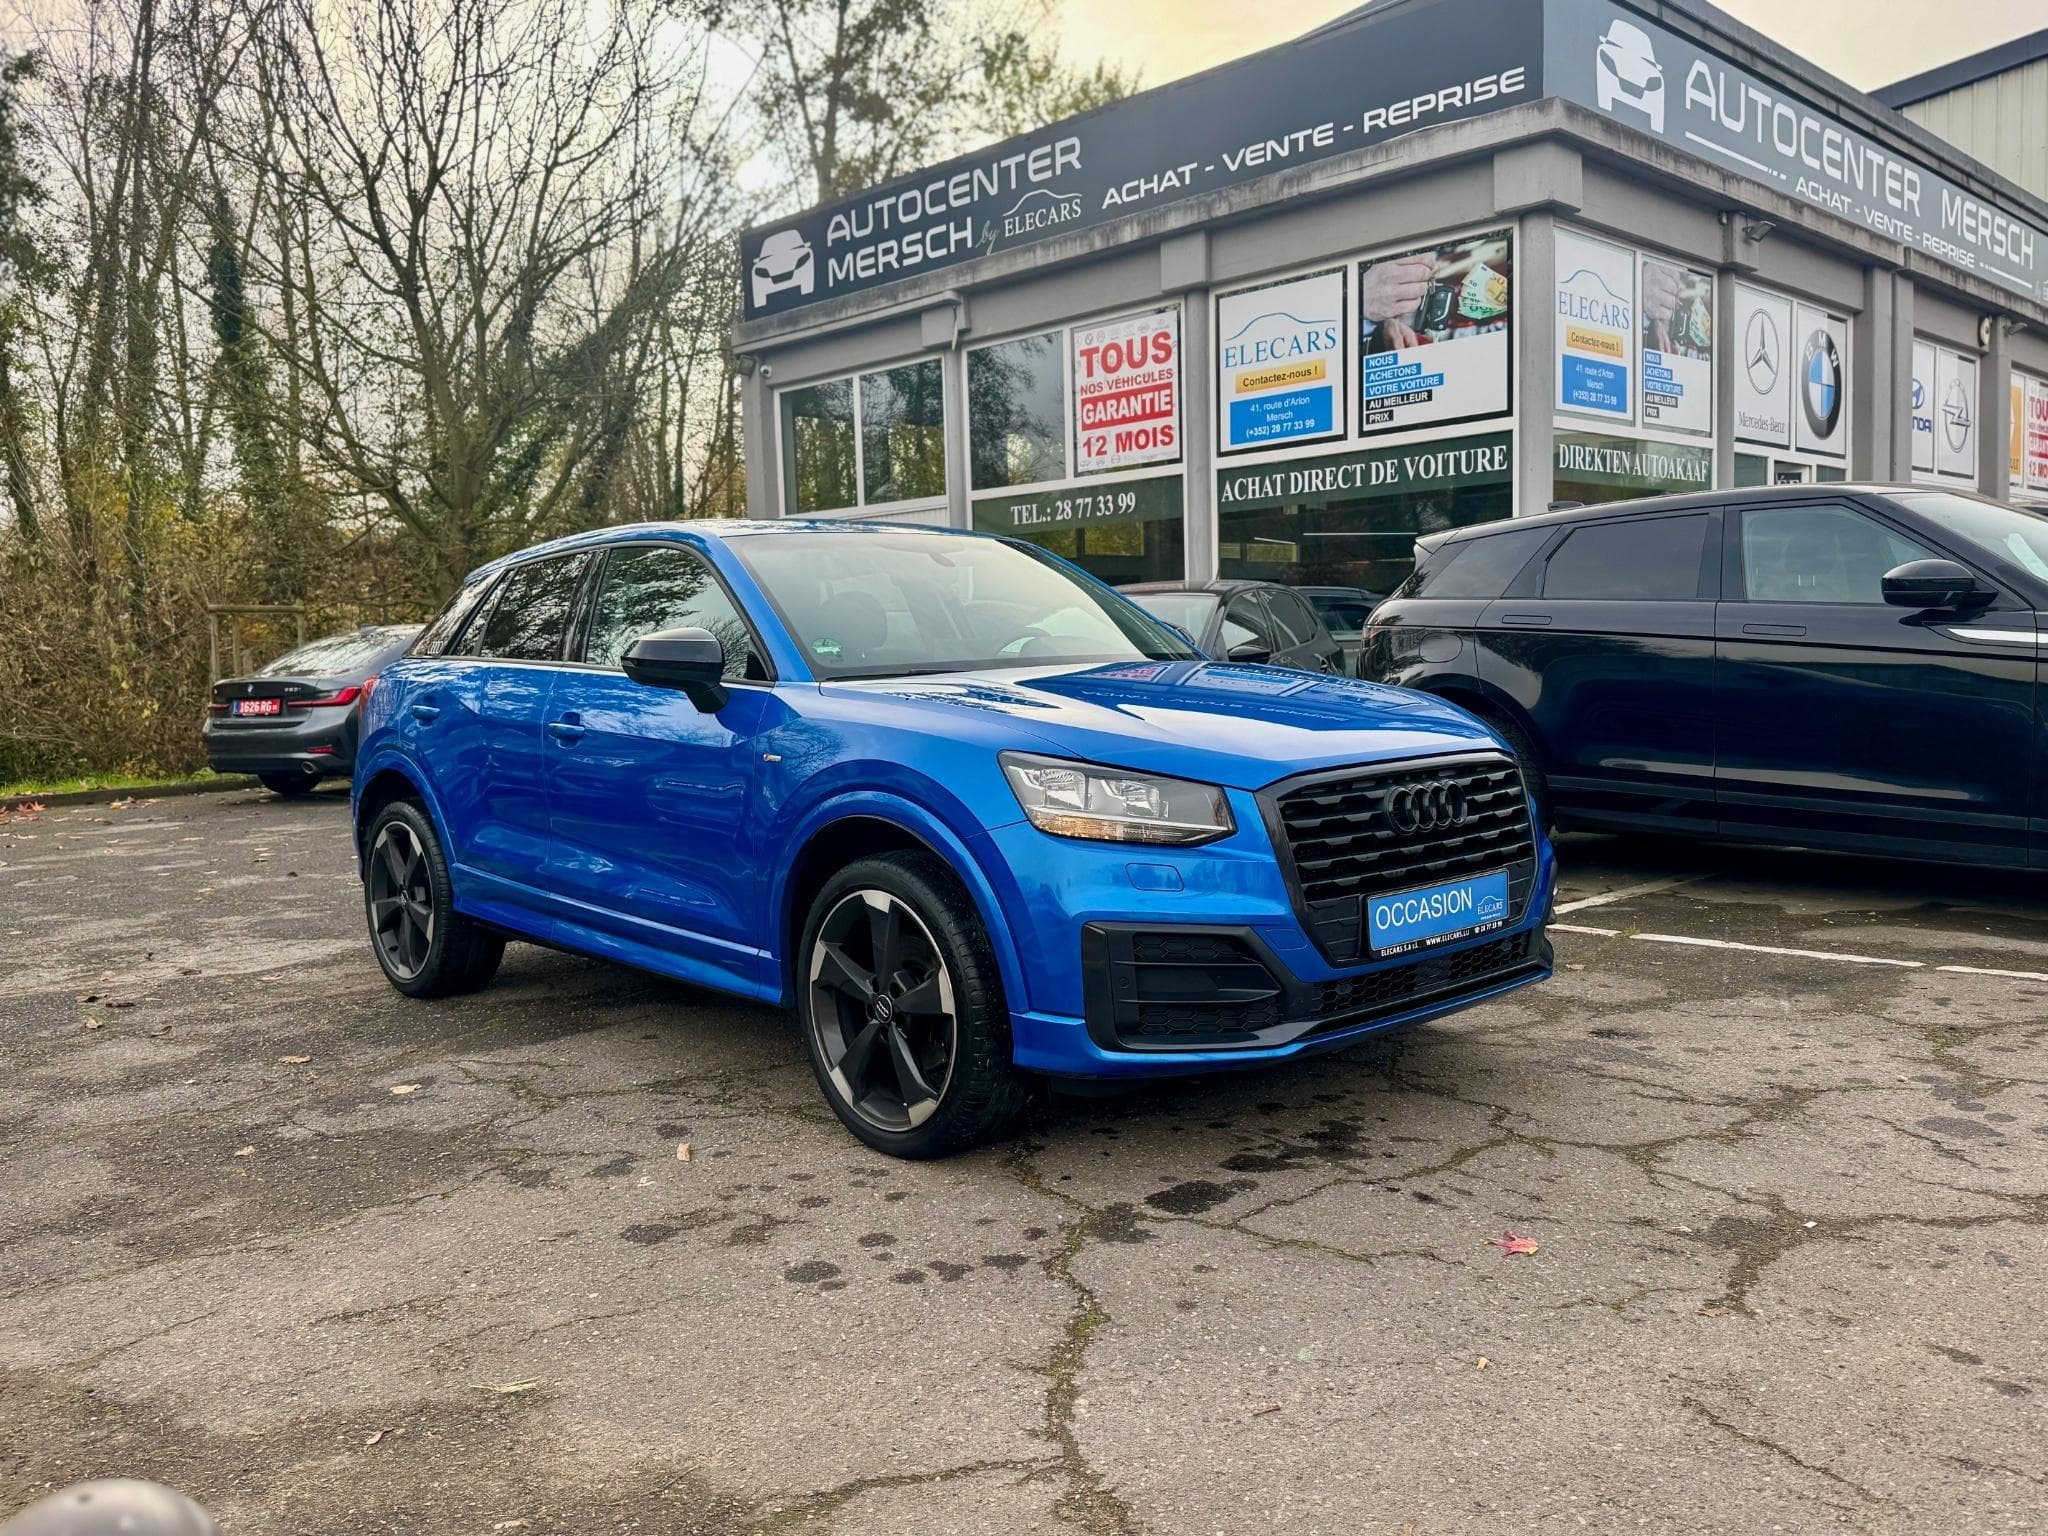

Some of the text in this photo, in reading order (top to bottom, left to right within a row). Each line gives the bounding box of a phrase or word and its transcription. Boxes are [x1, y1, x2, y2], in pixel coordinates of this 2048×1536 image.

[1101, 162, 1198, 210] ACHAT
[1222, 123, 1334, 172] VENTE
[1363, 66, 1526, 134] REPRISE
[1686, 60, 2034, 269] AUTOCENTER MERSCH
[827, 136, 1082, 247] AUTOCENTER
[1795, 177, 1852, 213] ACHAT
[1864, 211, 1913, 242] VENTE
[1922, 234, 1975, 268] REPRISE
[828, 198, 1082, 286] MERSCH by ELECARS
[1558, 290, 1630, 330] ELECARS
[1080, 331, 1172, 378] TOUS
[1224, 326, 1337, 368] ELECARS
[1369, 356, 1394, 367] NOUS
[1081, 368, 1174, 395] NOS VÉHICULES
[1242, 366, 1313, 388] Contactez-nous
[1369, 365, 1417, 381] ACHETONS
[1369, 376, 1439, 395] VOTRE VOITURE
[1082, 389, 1172, 425] GARANTIE
[1264, 400, 1282, 411] route
[1284, 396, 1310, 408] d'Arlon
[1266, 410, 1293, 422] Mersch
[1369, 392, 1428, 410] AU MEILLEUR
[2029, 396, 2048, 422] TOU
[1246, 418, 1315, 438] (+352) 28 77 33 99
[1369, 411, 1389, 423] PRIX
[1738, 411, 1785, 433] Mercedes-Benz
[1082, 424, 1175, 458] 12 MOIS
[1221, 445, 1508, 502] ACHAT DIRECT DE VOITURE
[1558, 443, 1709, 482] DIREKTEN AUTOAKAAF
[1010, 492, 1136, 525] TEL.: 28 77 33 99
[1376, 886, 1473, 930] OCCASION
[1477, 901, 1504, 916] ELECARS
[1381, 946, 1403, 957] ELECARS
